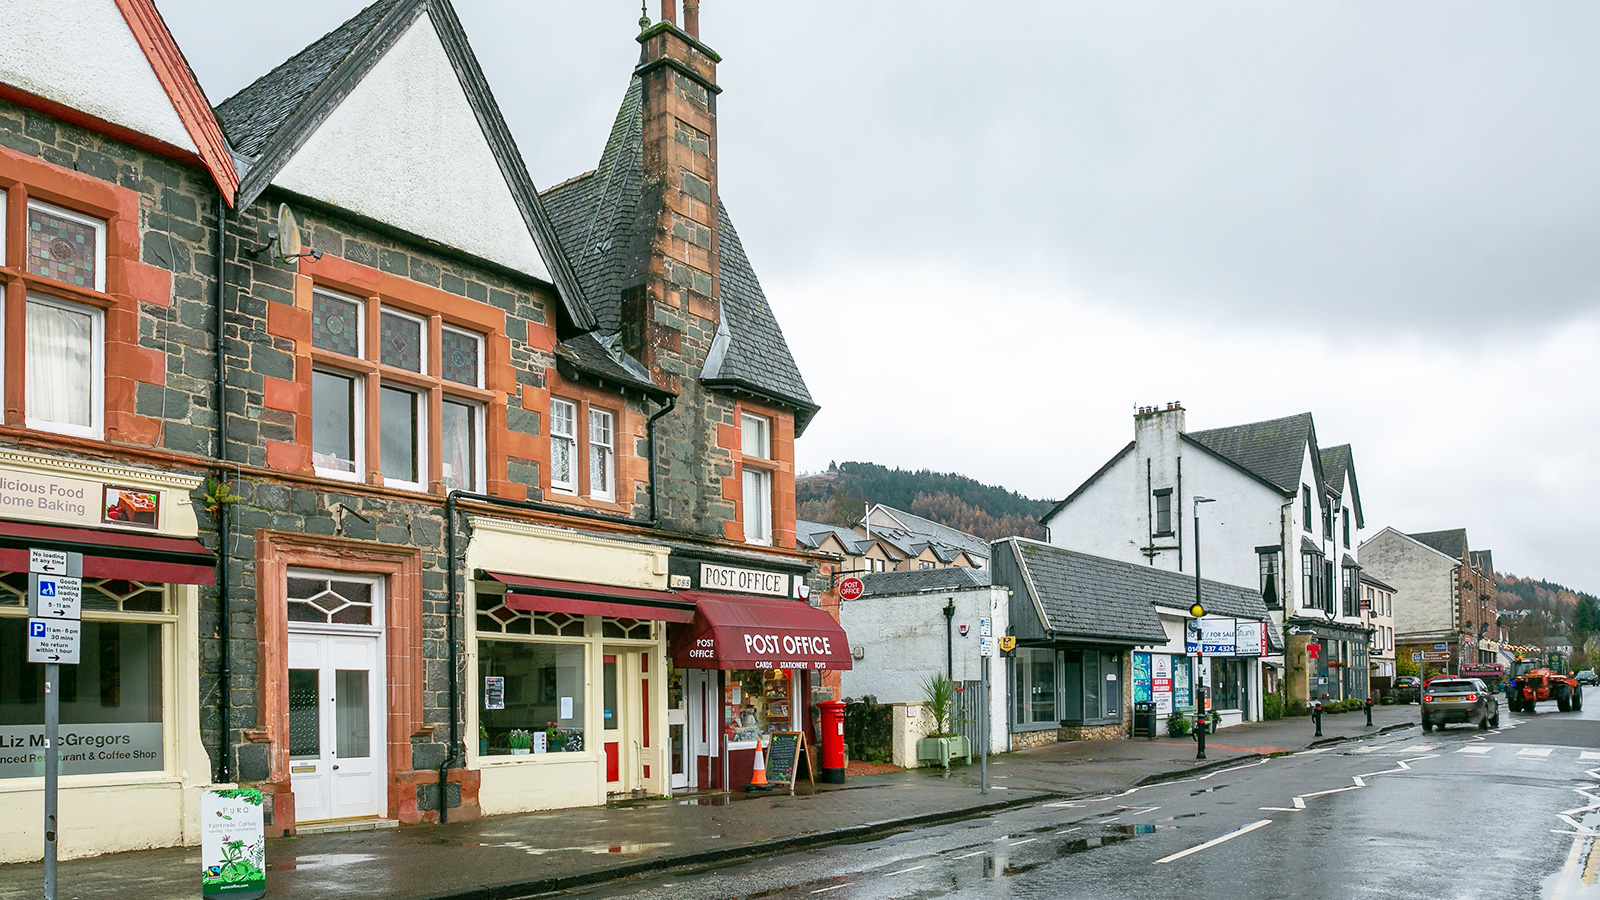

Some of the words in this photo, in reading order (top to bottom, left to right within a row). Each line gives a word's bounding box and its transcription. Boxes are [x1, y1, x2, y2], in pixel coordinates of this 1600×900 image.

[50, 484, 84, 498] Food
[38, 497, 85, 516] Baking
[43, 552, 64, 560] loading
[705, 567, 736, 586] POST
[738, 571, 781, 592] OFFICE
[841, 587, 860, 595] OFFICE
[34, 624, 43, 635] P
[744, 634, 779, 655] POST
[783, 635, 832, 655] OFFICE
[689, 650, 714, 658] OFFICE
[0, 735, 25, 748] Liz
[29, 733, 130, 748] McGregors
[0, 754, 26, 764] nced
[88, 752, 96, 760] &
[98, 750, 130, 760] Coffee
[133, 750, 157, 759] Shop
